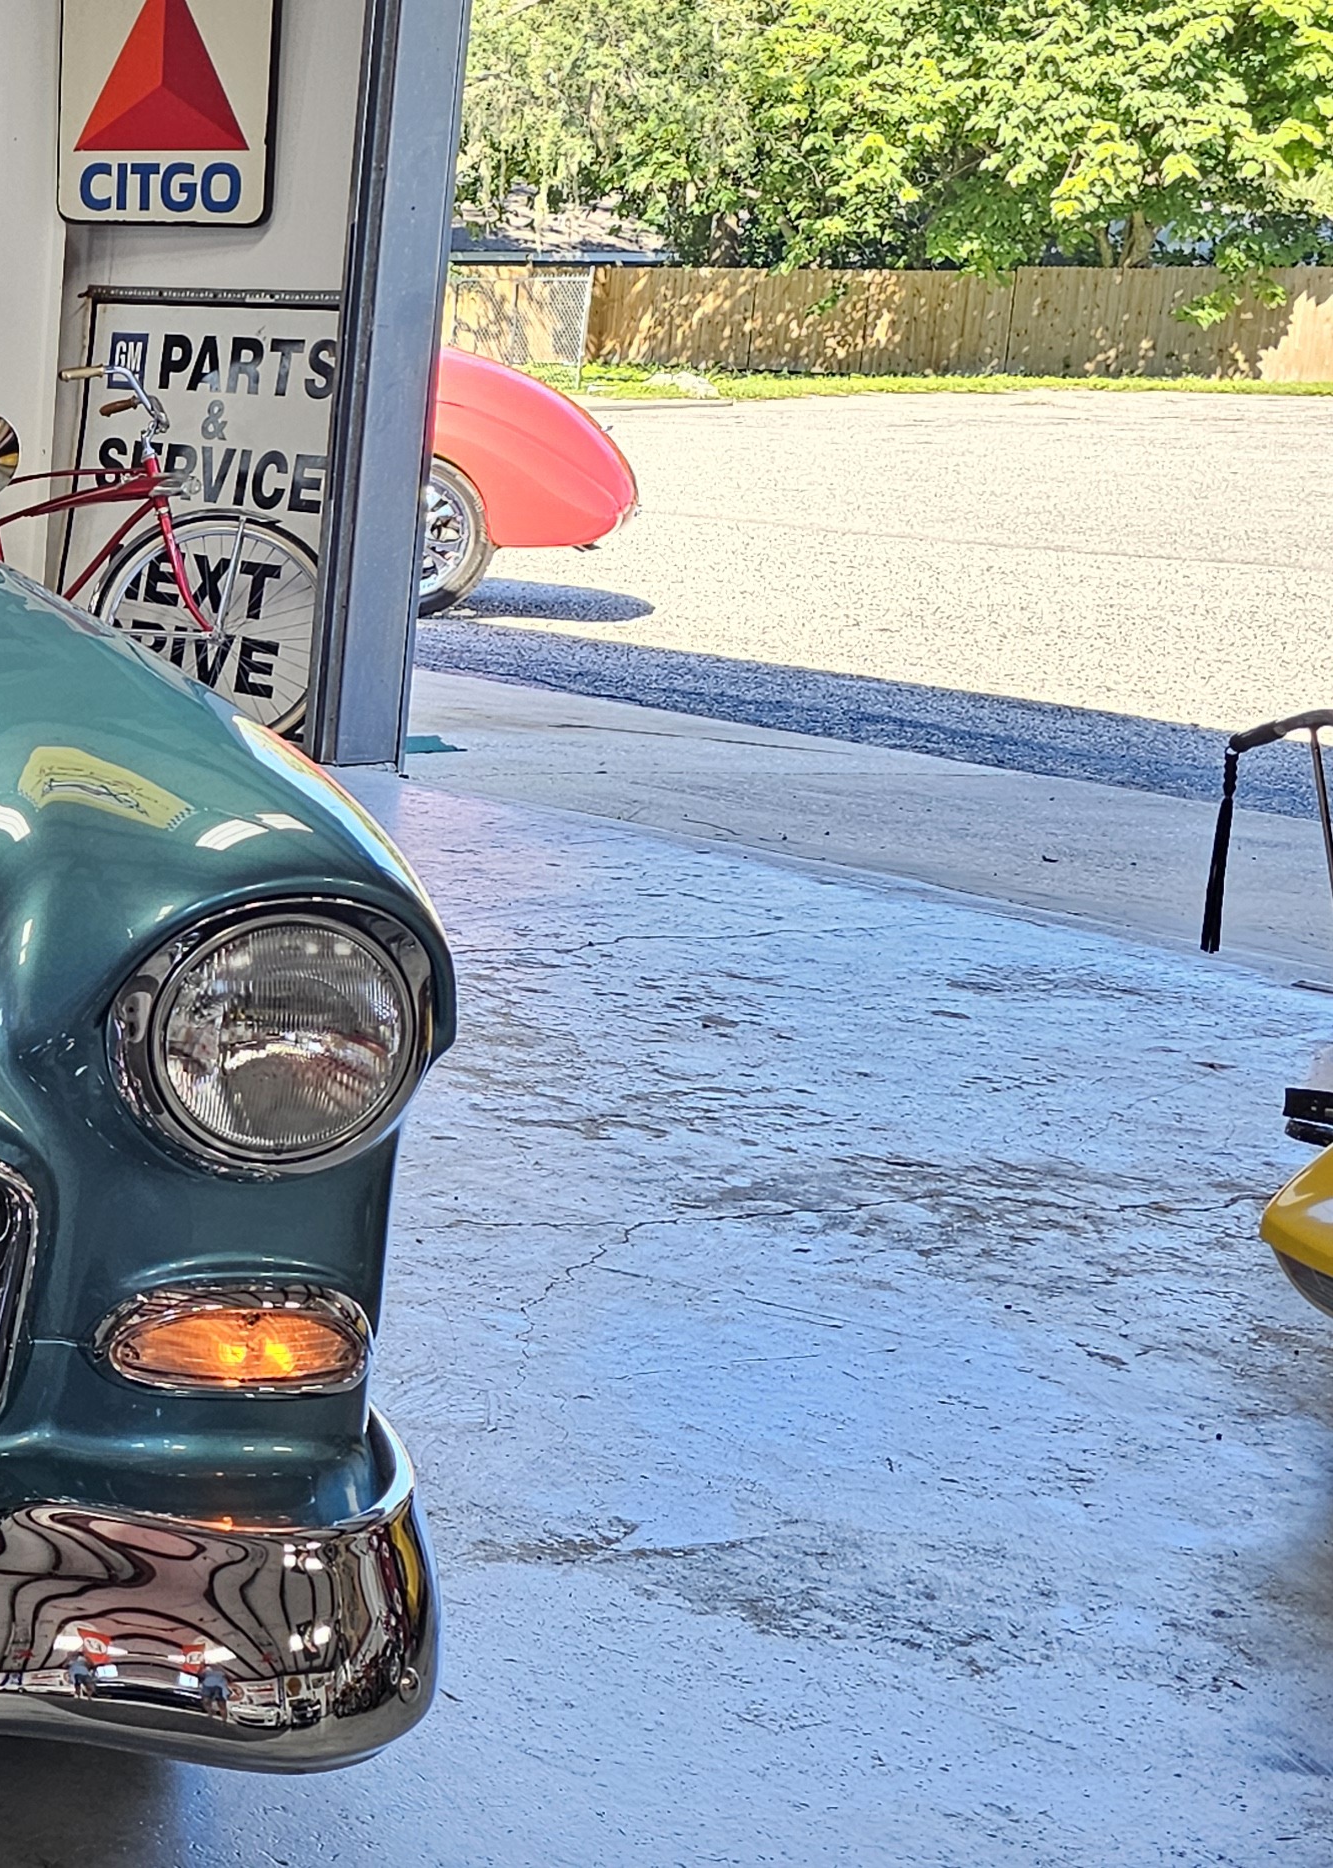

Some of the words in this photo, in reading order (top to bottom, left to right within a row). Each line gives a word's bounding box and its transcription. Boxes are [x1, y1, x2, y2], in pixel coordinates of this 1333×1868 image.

[79, 162, 242, 213] CITGO
[114, 339, 145, 376] GM
[158, 333, 337, 399] PARTS
[200, 400, 227, 440] &
[112, 617, 280, 699] RIVE
